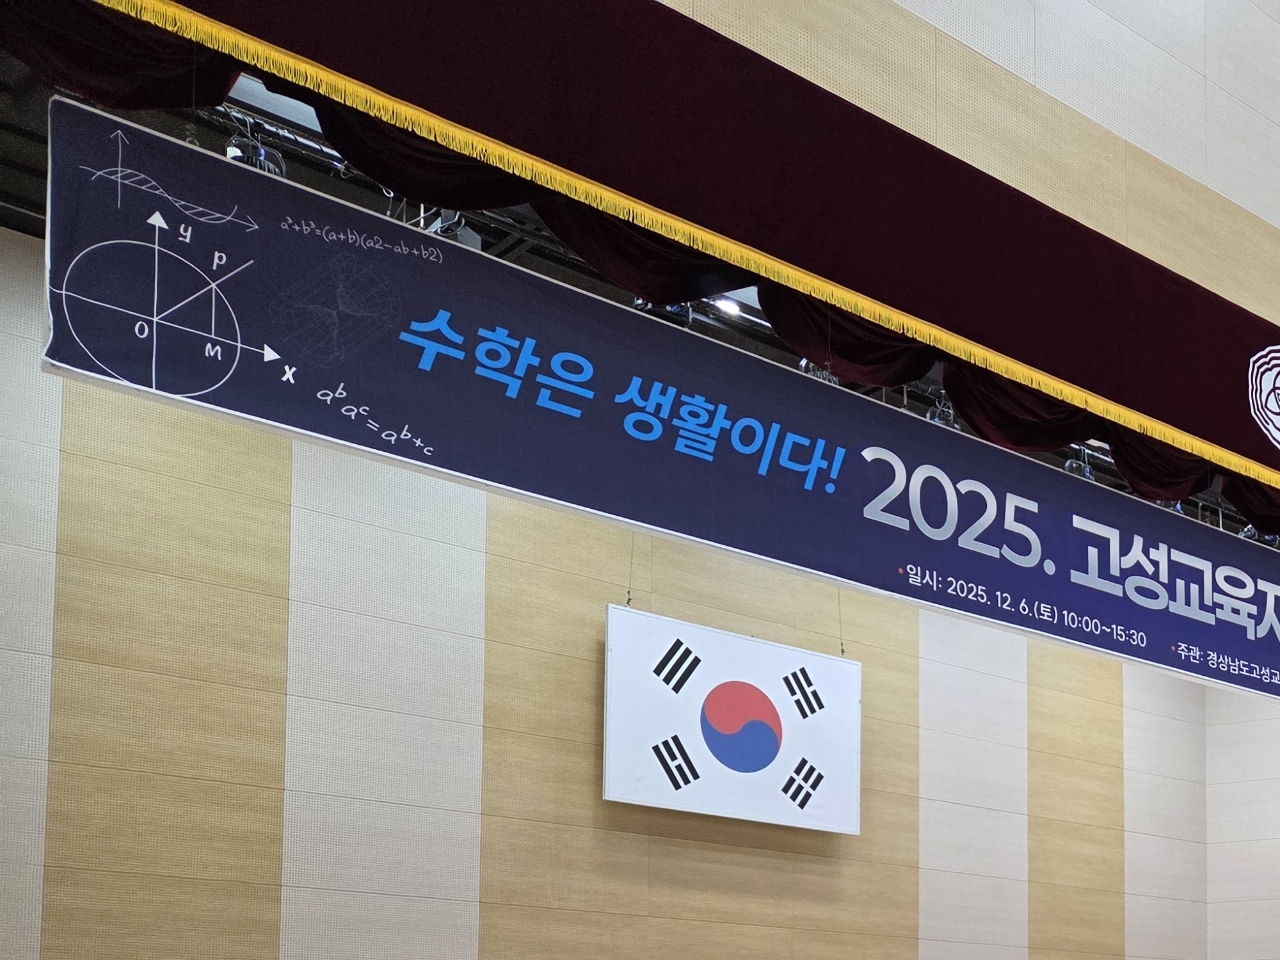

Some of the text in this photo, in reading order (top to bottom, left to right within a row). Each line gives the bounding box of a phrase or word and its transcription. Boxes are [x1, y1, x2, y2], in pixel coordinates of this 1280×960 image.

[399, 308, 847, 494] 수학은 생활이다!
[860, 446, 1057, 577] 2025.
[906, 564, 943, 591] 일시:
[947, 577, 991, 605] 2025.
[995, 591, 1016, 612] 12.
[1062, 610, 1147, 647] 10:00~15:30
